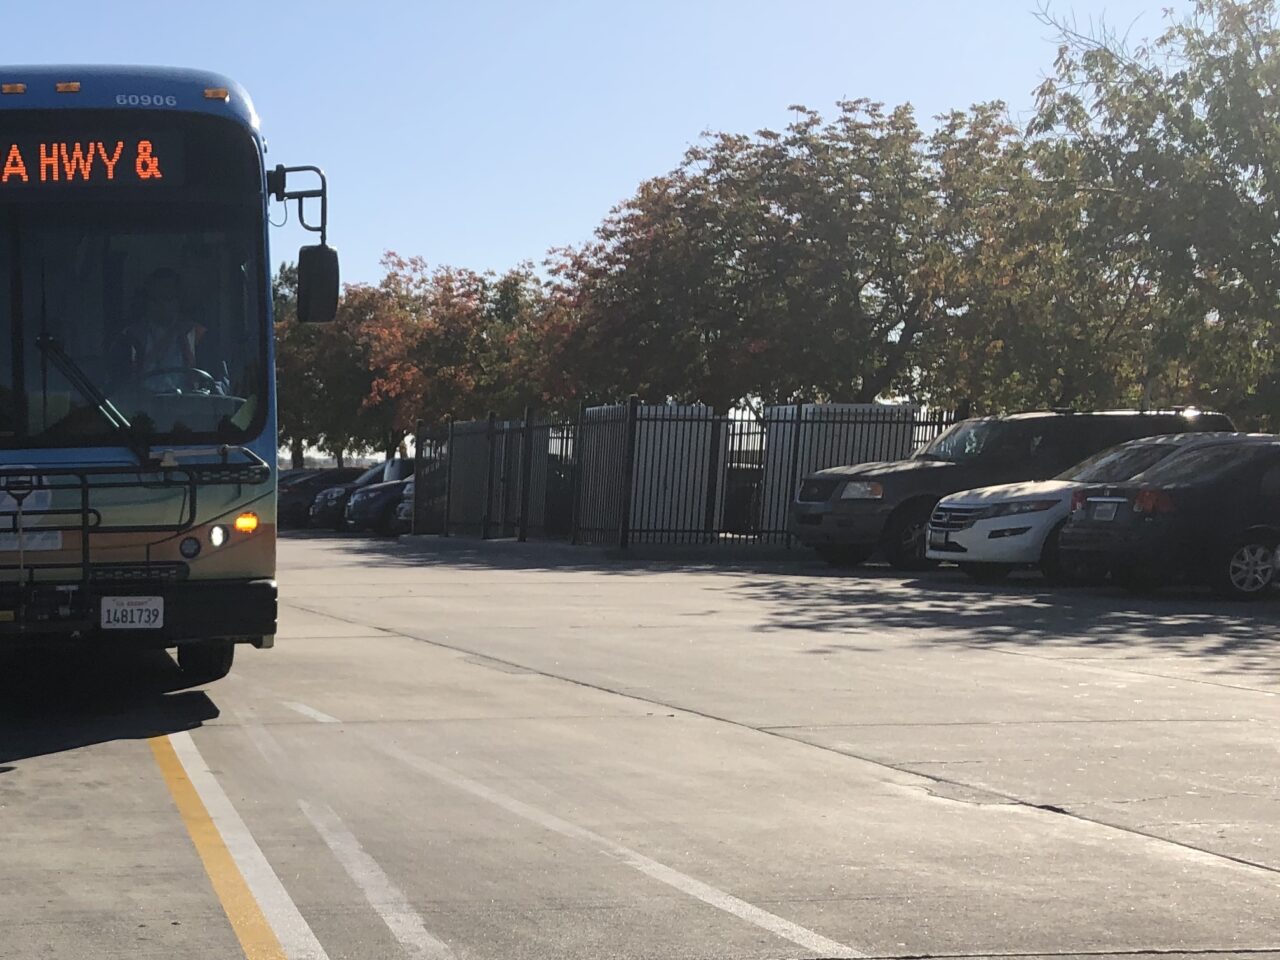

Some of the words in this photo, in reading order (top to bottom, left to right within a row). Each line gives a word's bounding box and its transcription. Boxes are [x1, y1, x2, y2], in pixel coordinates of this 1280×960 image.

[115, 94, 177, 106] 60906
[40, 141, 123, 181] HWY
[135, 140, 162, 178] &
[105, 608, 159, 624] 1481739
